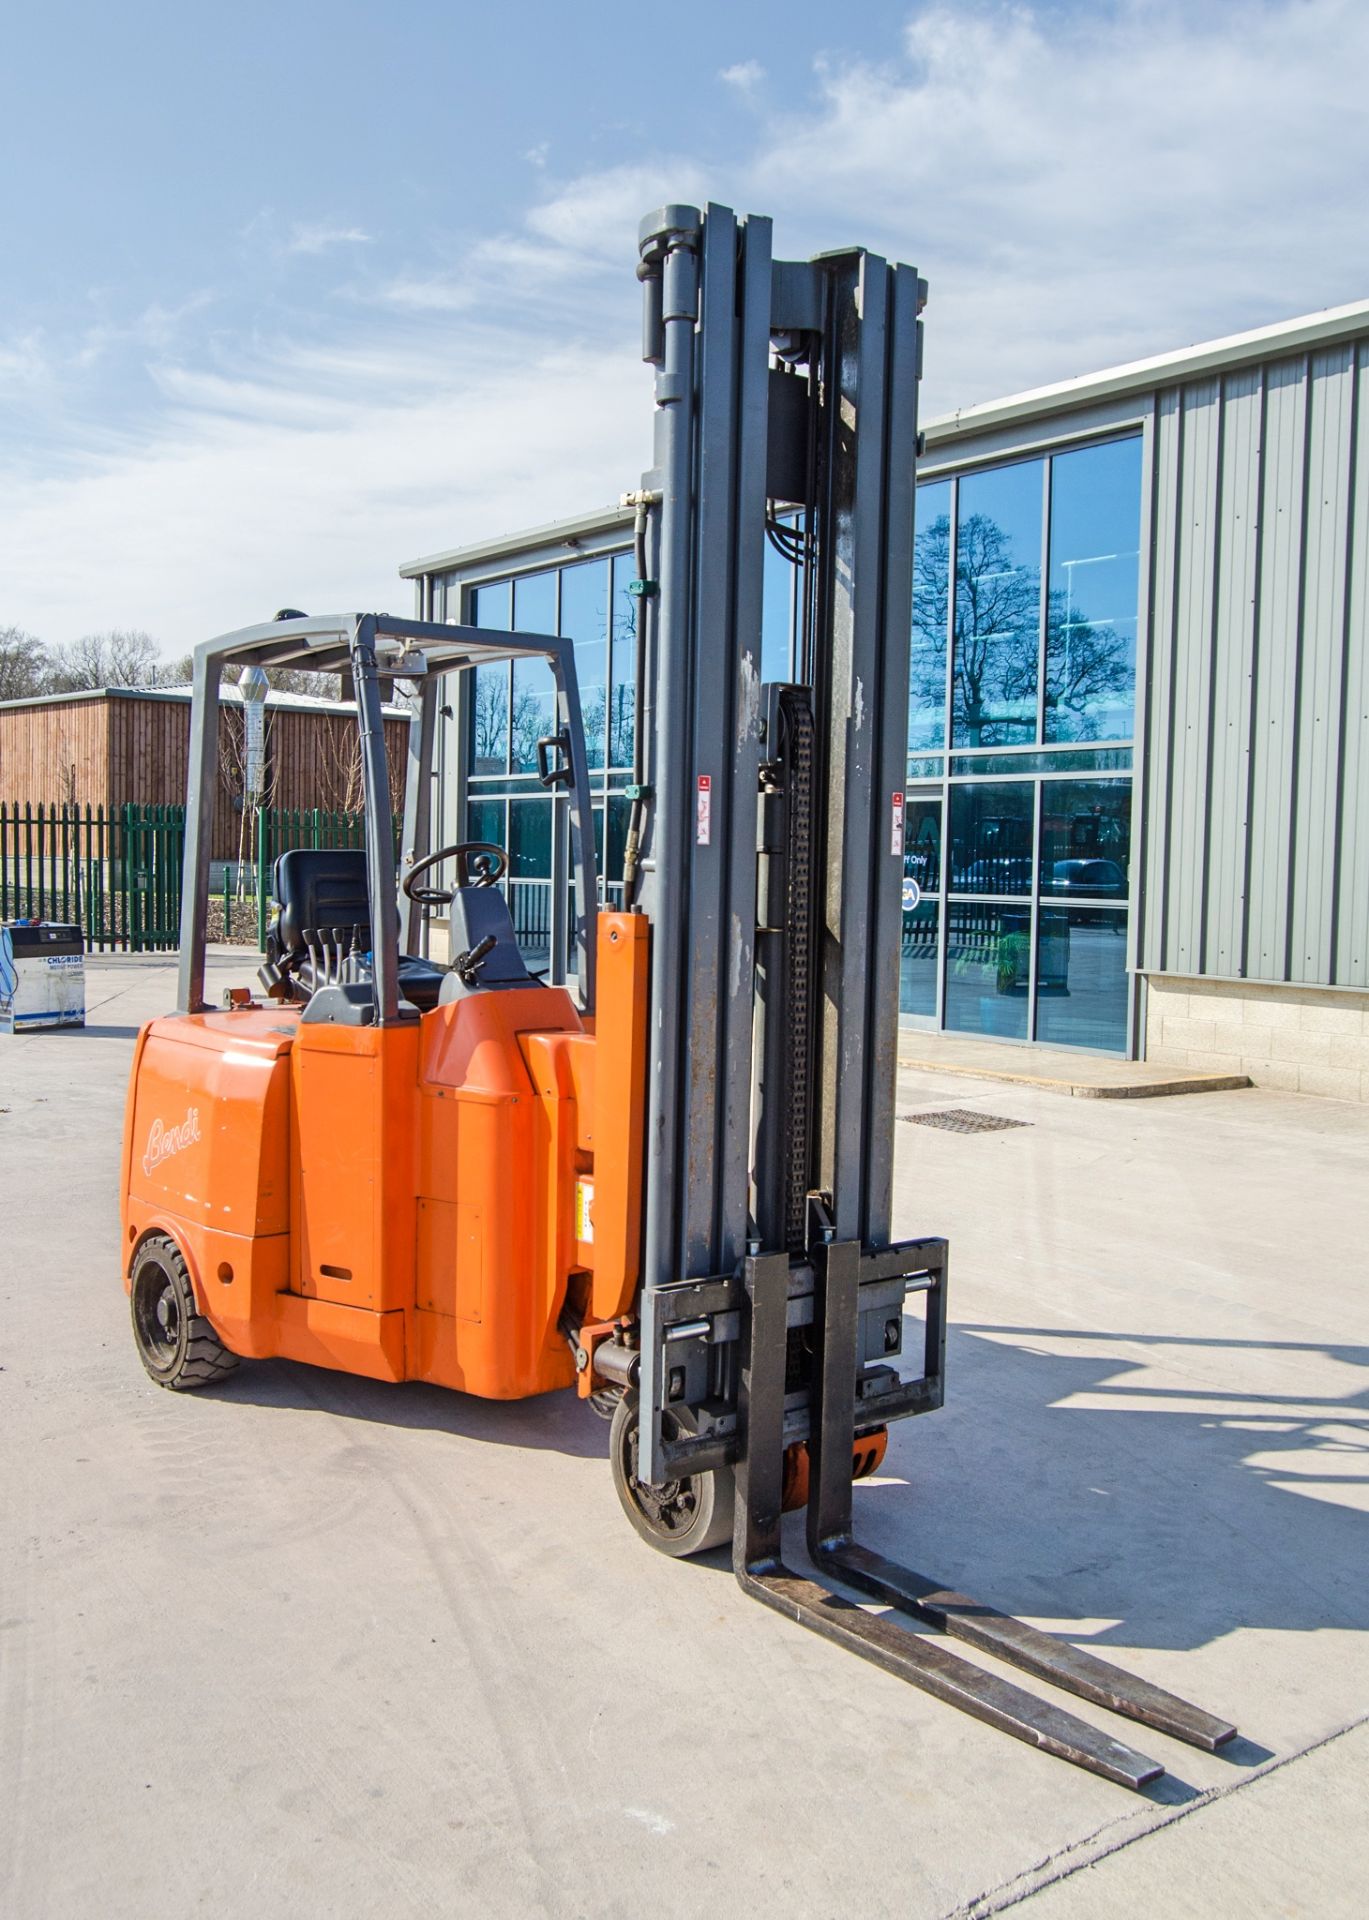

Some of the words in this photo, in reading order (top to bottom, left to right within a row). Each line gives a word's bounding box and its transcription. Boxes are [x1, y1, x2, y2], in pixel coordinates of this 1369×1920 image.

[911, 855, 928, 866] Only
[48, 955, 83, 964] CHLORIDE
[142, 1107, 201, 1177] Bendi
